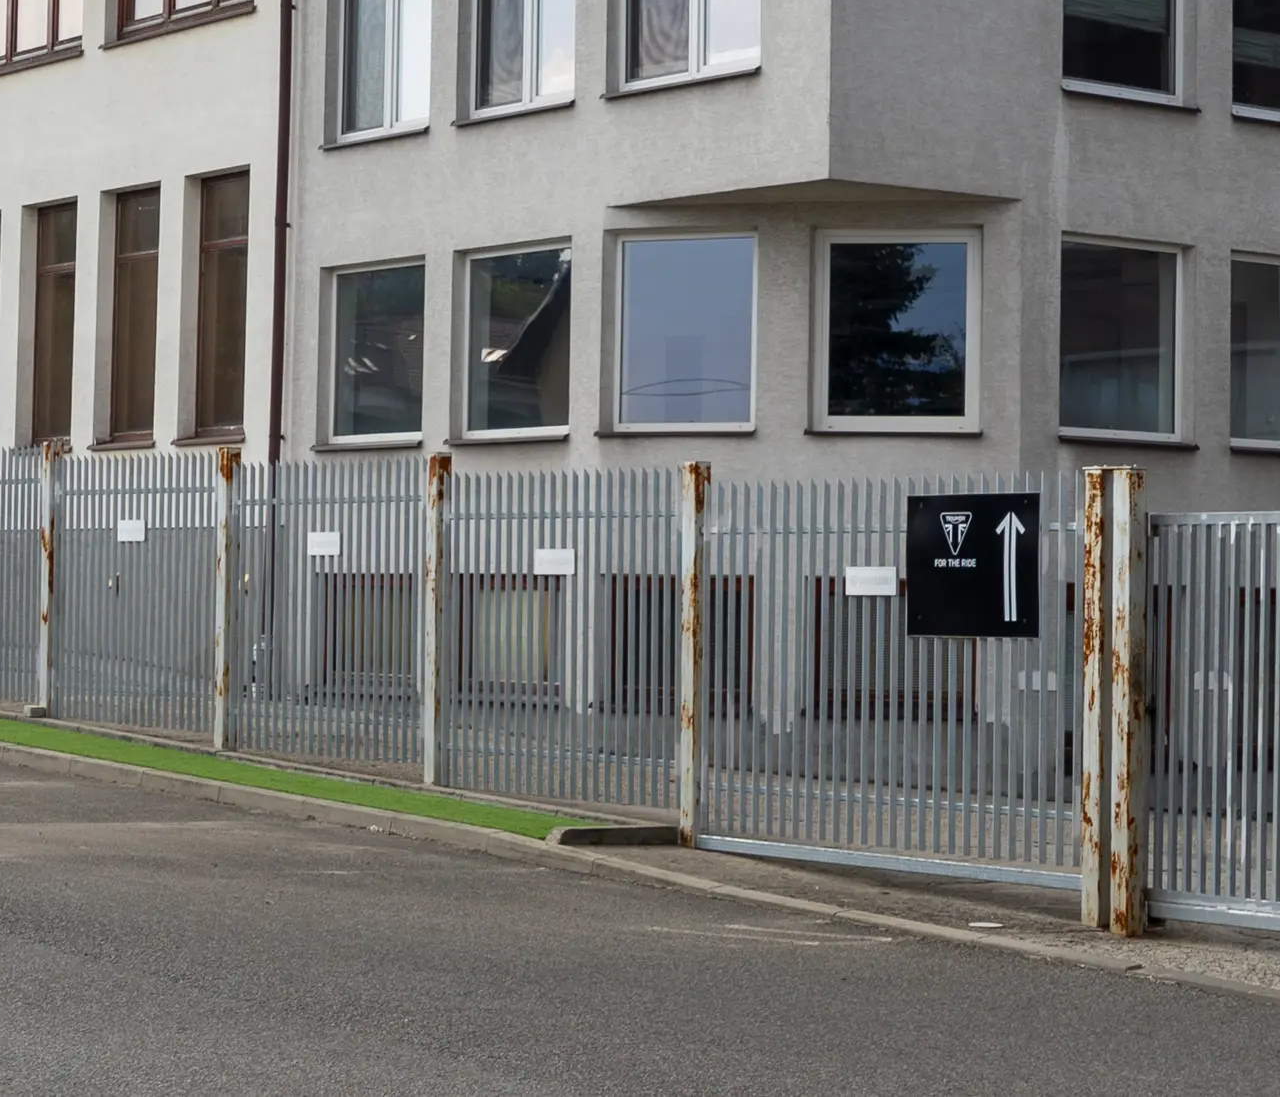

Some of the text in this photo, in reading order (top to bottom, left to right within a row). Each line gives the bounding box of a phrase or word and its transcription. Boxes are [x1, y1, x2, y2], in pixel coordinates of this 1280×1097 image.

[934, 558, 976, 568] FOR THE RIDE
